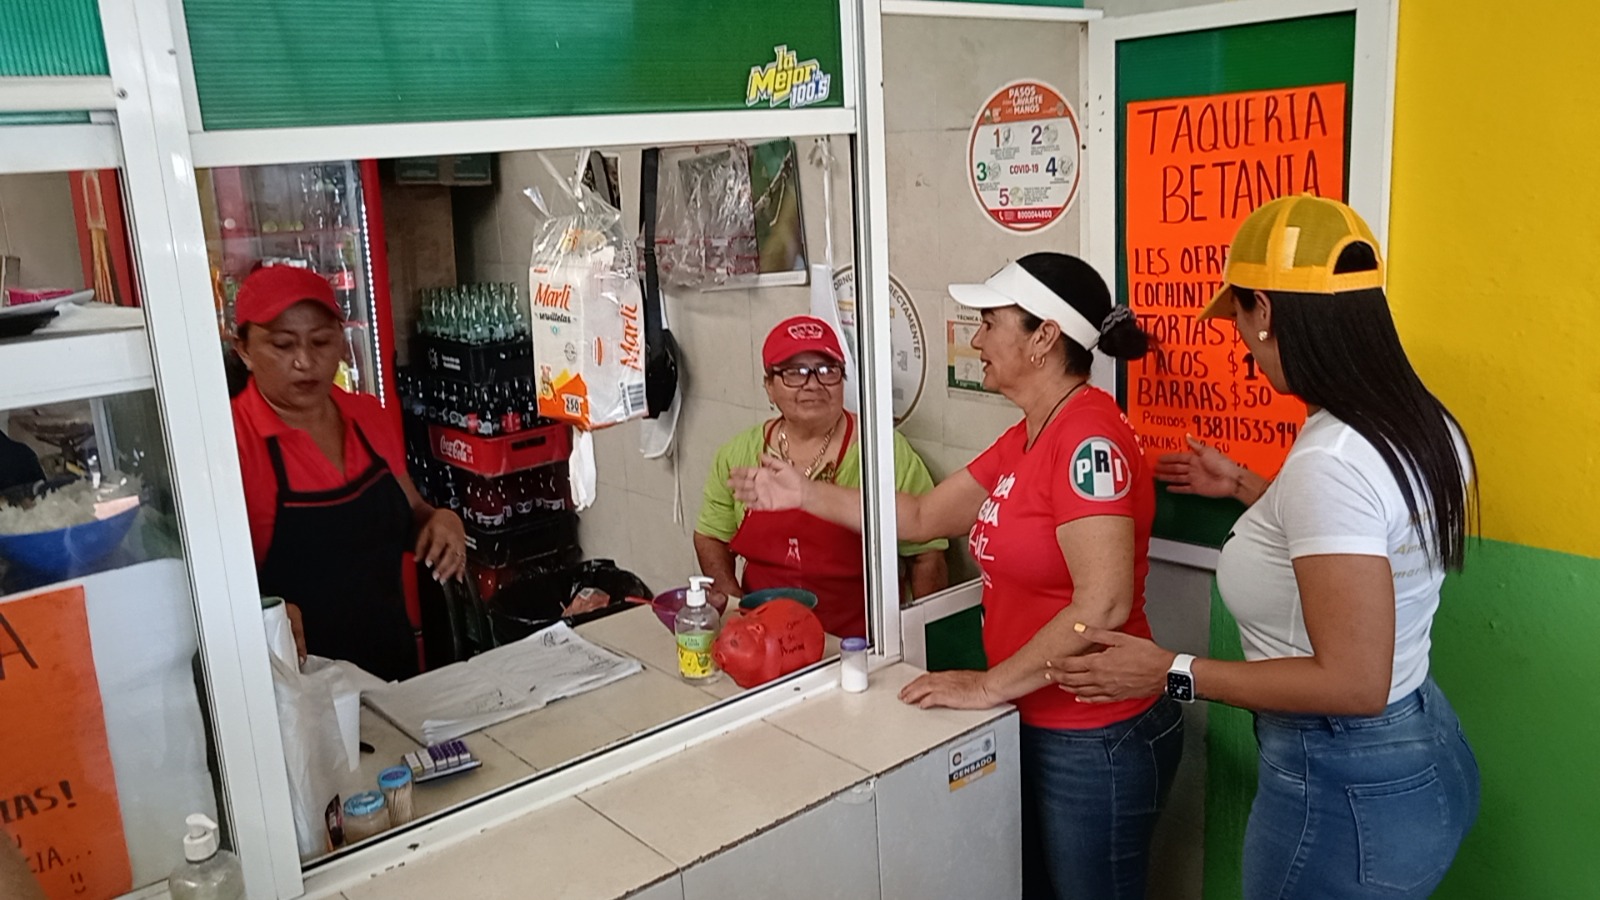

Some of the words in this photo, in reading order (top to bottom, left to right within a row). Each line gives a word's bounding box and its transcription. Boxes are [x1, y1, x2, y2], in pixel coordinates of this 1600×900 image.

[748, 64, 817, 103] Mejor
[1008, 85, 1036, 99] PASOS
[1014, 102, 1040, 115] MANOS
[1031, 125, 1042, 145] 2
[1137, 91, 1327, 155] TAQUERIA
[993, 128, 1000, 148] 1
[976, 162, 988, 181] 3
[1009, 163, 1039, 175] COVID-19
[1045, 156, 1058, 177] 4
[998, 187, 1009, 206] 5
[1159, 149, 1321, 224] BETANIA
[1135, 247, 1170, 277] LES
[534, 283, 571, 311] Marli
[620, 303, 642, 372] Marli
[1136, 314, 1225, 346] TORTAS
[1140, 350, 1209, 379] TACOS
[1137, 377, 1227, 412] BARRAS
[1230, 381, 1272, 411] $50
[1139, 434, 1183, 453] RACIAS!
[1192, 414, 1298, 449] 9381153594
[1076, 450, 1124, 485] PRI
[952, 755, 993, 781] CENSADO
